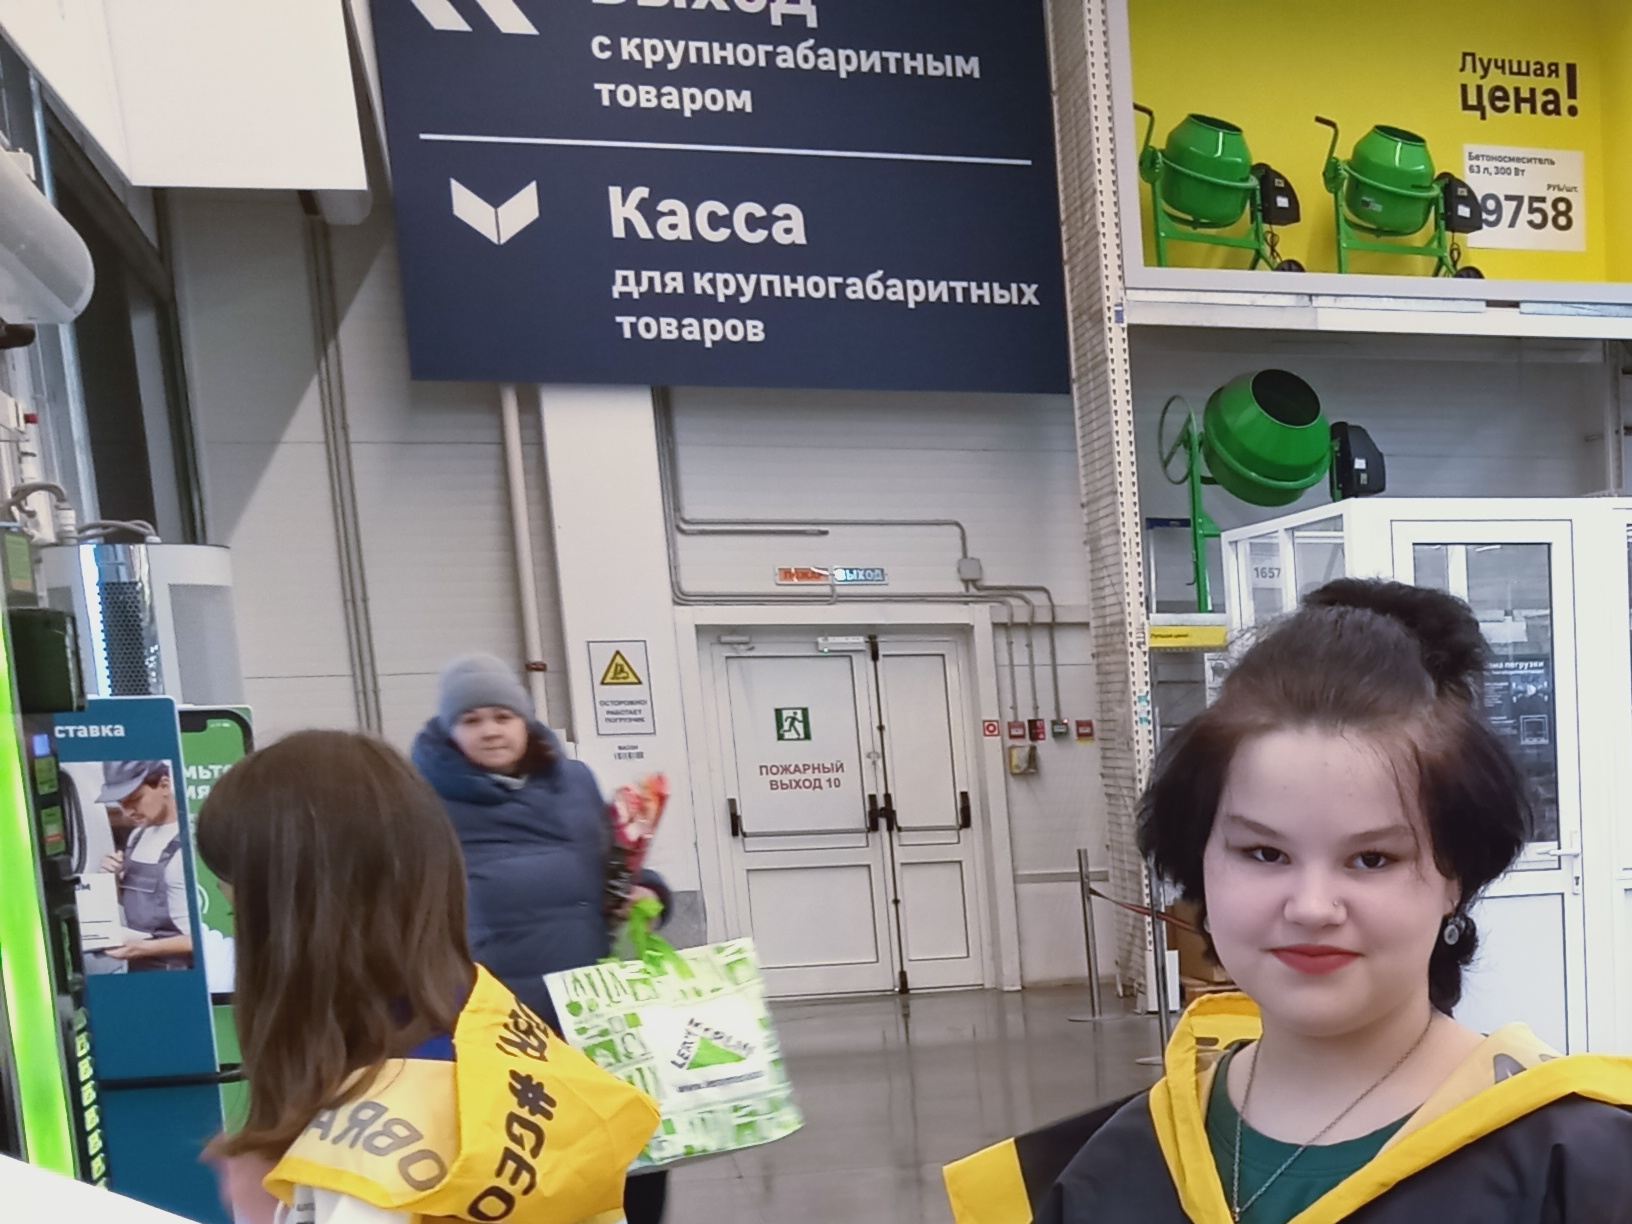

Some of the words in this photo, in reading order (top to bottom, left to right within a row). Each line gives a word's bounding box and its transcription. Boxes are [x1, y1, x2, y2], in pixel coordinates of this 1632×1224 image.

[591, 35, 612, 60] с
[620, 37, 981, 79] крупногабаритным
[1459, 51, 1560, 80] Лучшая
[595, 81, 752, 117] товаром
[1459, 62, 1579, 120] цена!
[1468, 151, 1556, 166] Бетоносмеситель
[1469, 165, 1480, 174] 63
[1494, 166, 1512, 176] 300
[1514, 168, 1525, 176] Вт
[608, 186, 807, 246] Касса
[1480, 192, 1573, 231] 9758
[612, 268, 685, 298] для
[694, 269, 1040, 310] крупногабаритных
[616, 313, 765, 347] товаров
[835, 568, 882, 580] ЫХОД
[1254, 567, 1281, 578] 1657
[759, 760, 844, 776] ПОЖАРНЫЙ
[770, 778, 823, 791] ВЫХОД
[826, 778, 841, 788] 10
